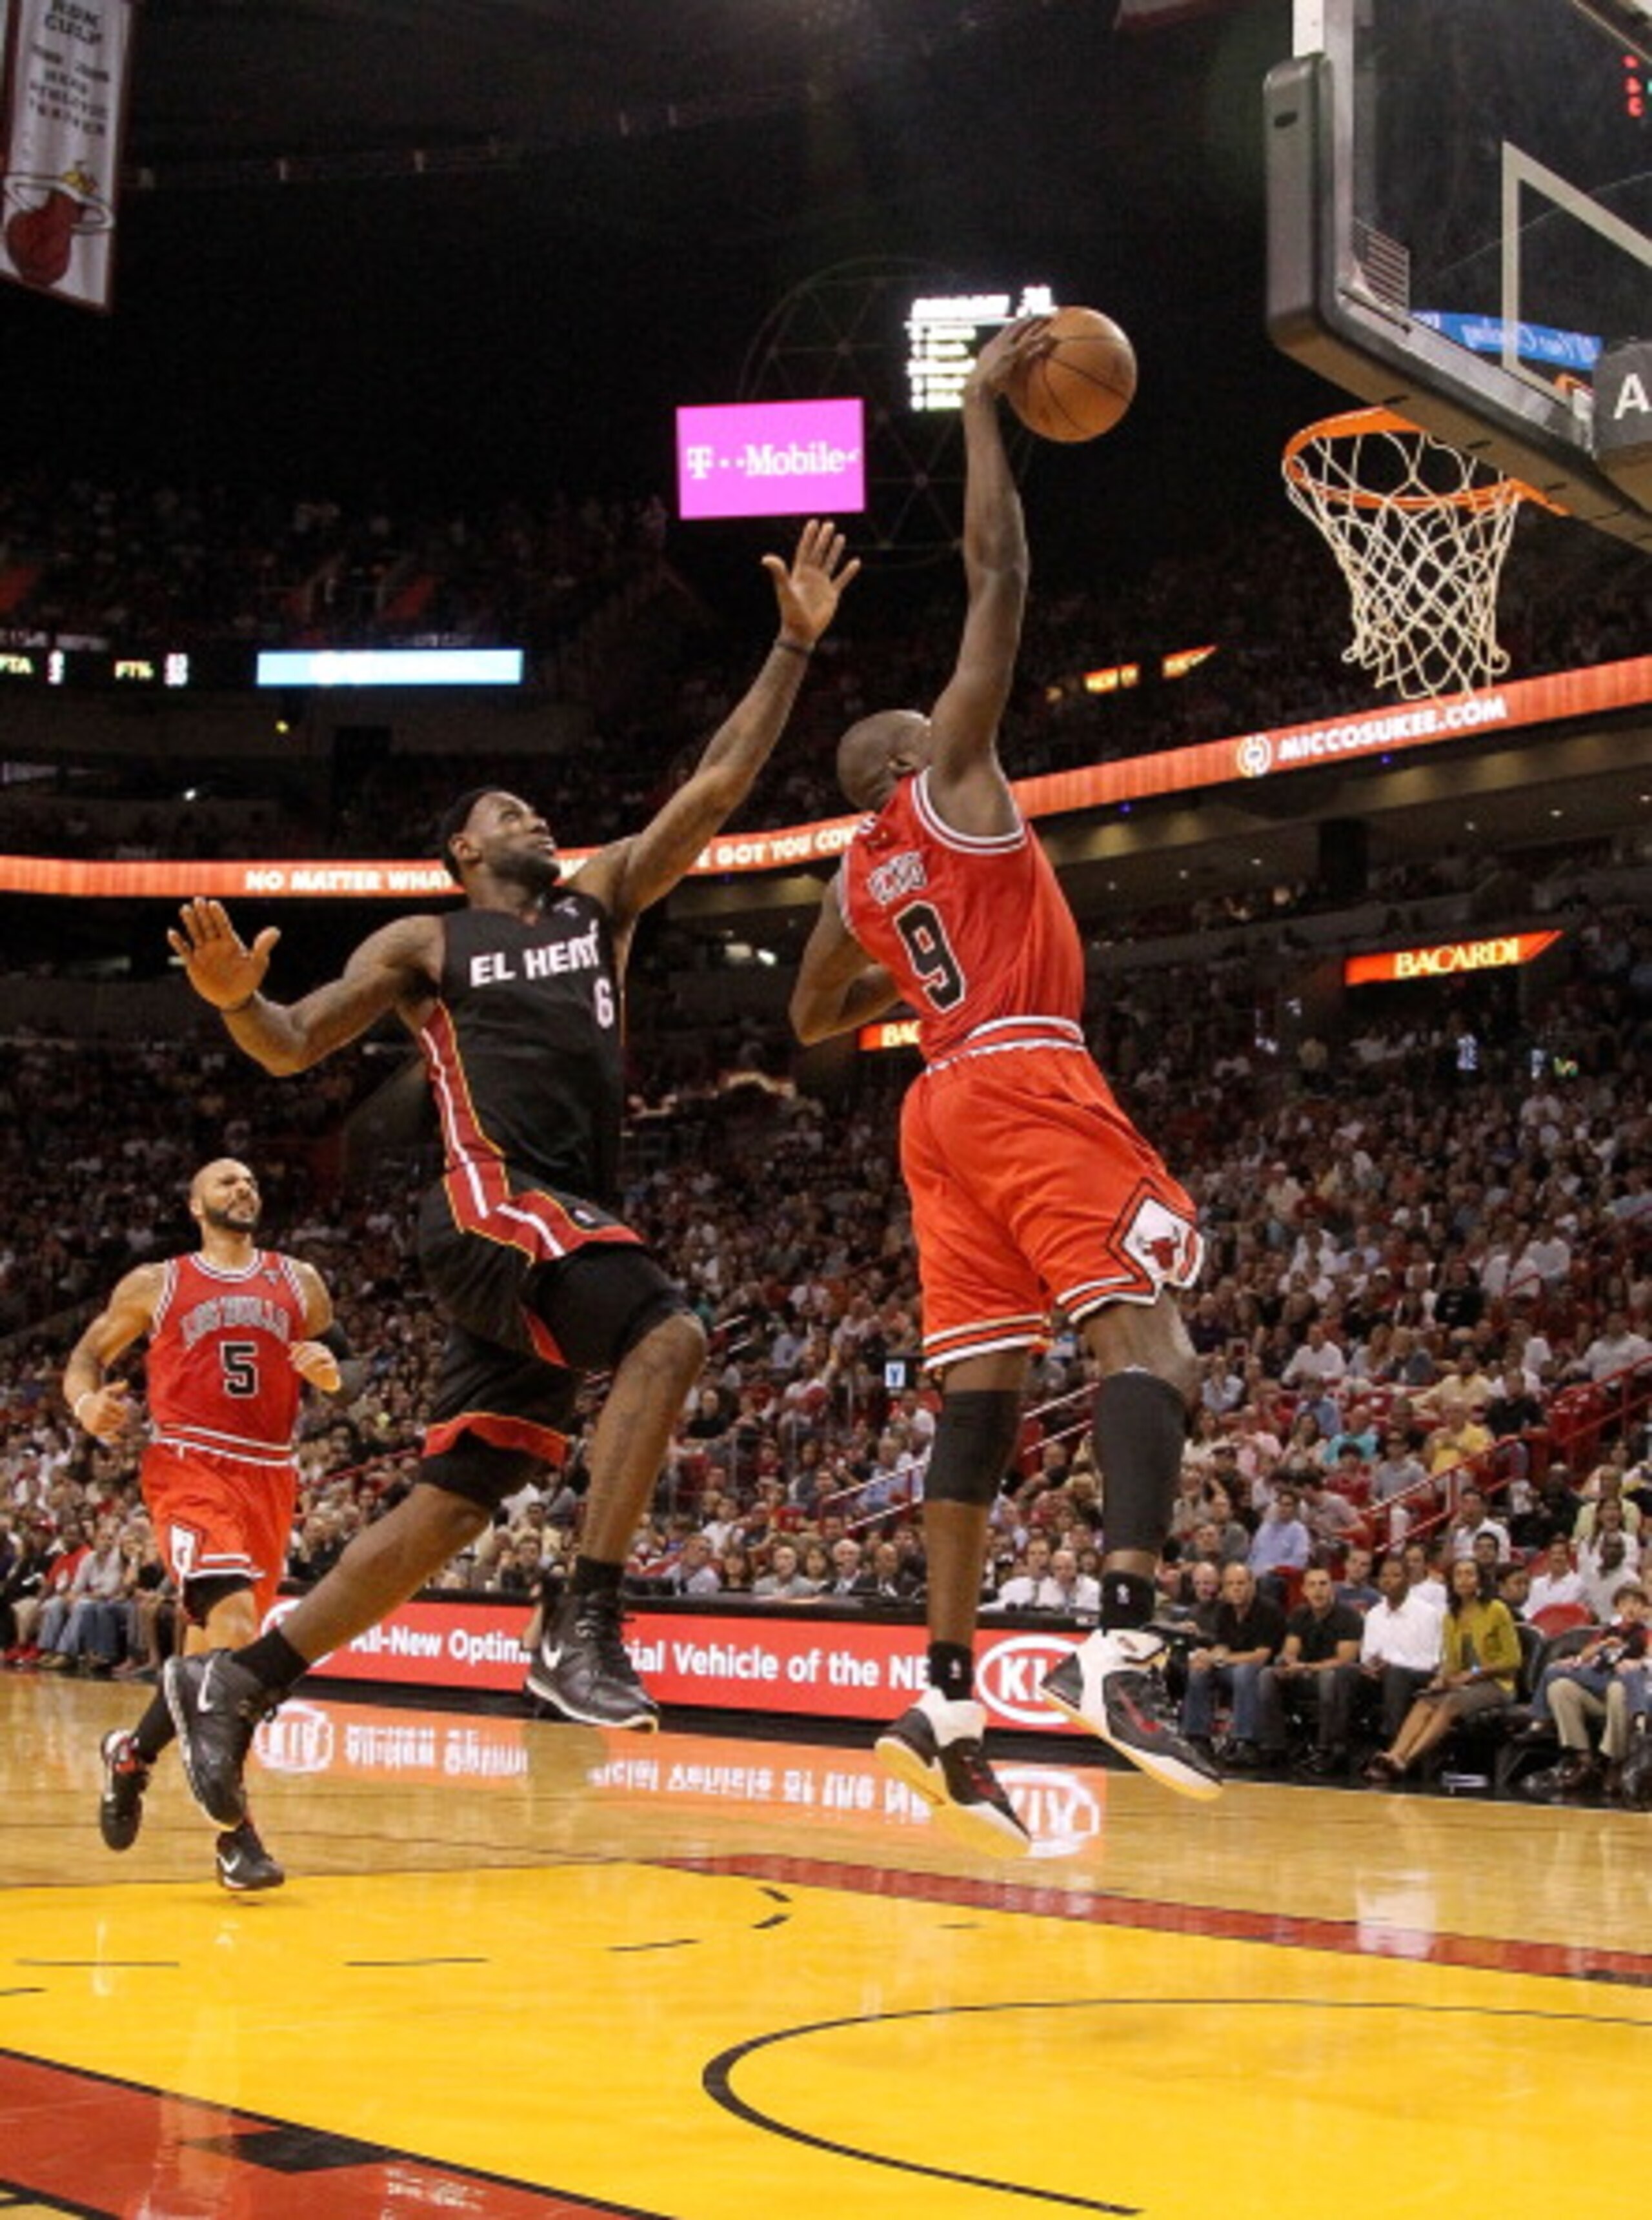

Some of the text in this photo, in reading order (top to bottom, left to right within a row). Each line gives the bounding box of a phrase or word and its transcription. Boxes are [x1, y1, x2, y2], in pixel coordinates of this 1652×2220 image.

[1614, 373, 1652, 419] A
[1278, 695, 1506, 759] MICCOSUKEE.COM
[716, 843, 765, 865] GOT
[771, 834, 810, 859] YOU
[814, 825, 858, 851] COV
[246, 871, 283, 889] NO
[291, 871, 380, 890] MATTER
[470, 919, 599, 988] EL HEAT
[893, 900, 965, 1014] 9
[1395, 938, 1518, 978] BACARDI
[594, 977, 614, 1029] 6
[219, 1341, 258, 1399] 5
[625, 1638, 664, 1673] ial
[672, 1643, 778, 1679] Vehicle
[787, 1648, 821, 1683] of
[829, 1651, 879, 1687] the
[1002, 1656, 1052, 1701] KI
